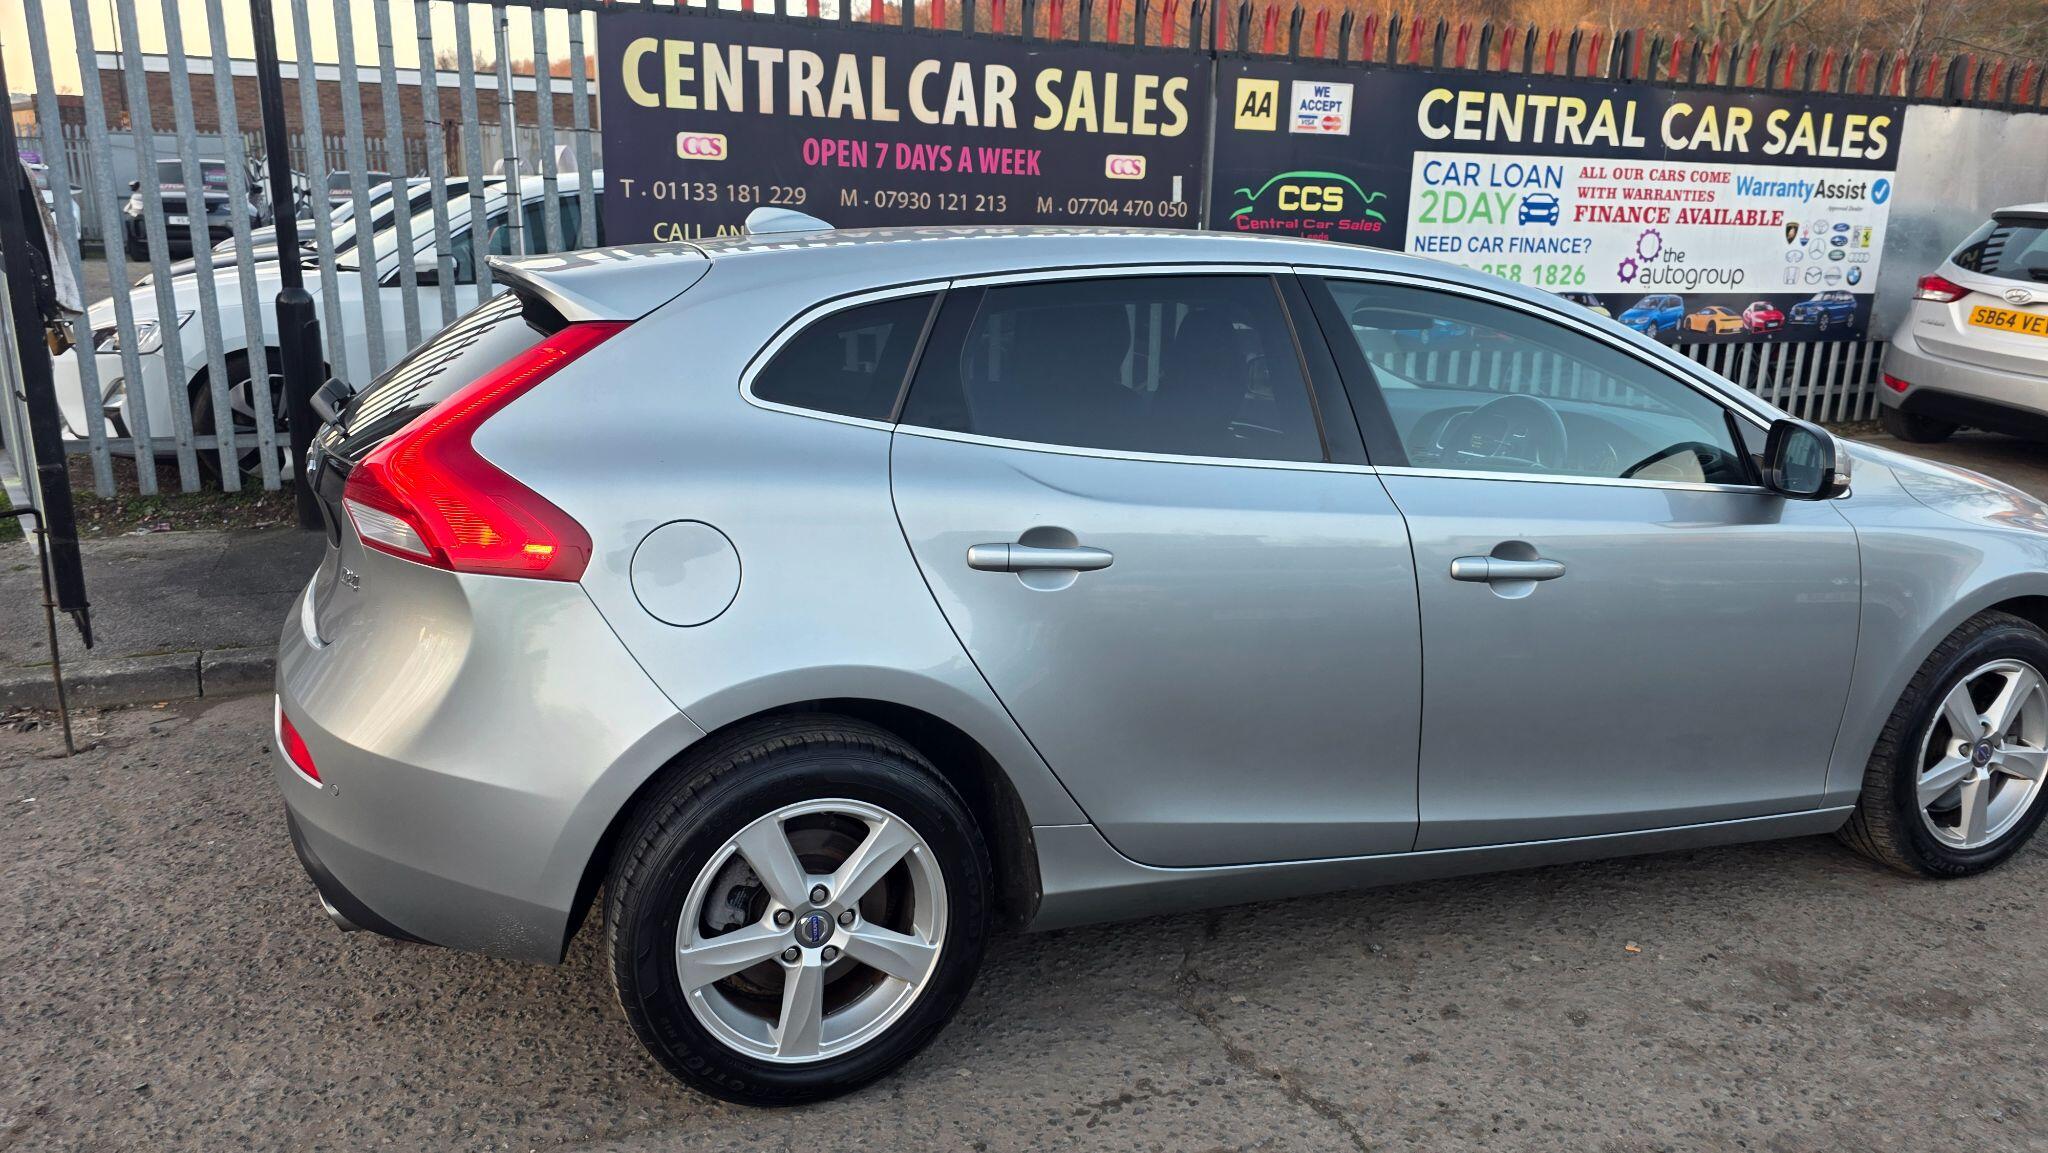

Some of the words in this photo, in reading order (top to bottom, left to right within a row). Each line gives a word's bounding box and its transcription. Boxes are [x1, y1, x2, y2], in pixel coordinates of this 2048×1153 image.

[622, 37, 900, 122] CENTRAL
[908, 59, 1018, 129] CAR
[1033, 67, 1189, 137] SALES
[1314, 86, 1331, 98] WE
[1240, 90, 1272, 118] AA
[1300, 99, 1342, 112] ACCEPT
[1417, 87, 1646, 148] CENTRAL
[1660, 102, 1753, 153] CAR
[1762, 108, 1892, 160] SALES
[802, 137, 868, 169] OPEN
[874, 142, 889, 169] 7
[896, 143, 953, 173] DAYS
[958, 146, 973, 173] A
[978, 147, 1042, 176] WEEK
[1423, 160, 1481, 187] CAR
[1490, 163, 1564, 189] LOAN
[1578, 166, 1607, 180] ALL
[1613, 167, 1644, 181] OUR
[1649, 168, 1686, 182] CARS
[1690, 170, 1731, 184] COME
[652, 180, 718, 202] 01133
[726, 184, 760, 203] 181
[769, 185, 807, 205] 229
[874, 190, 931, 209] 07930
[938, 193, 967, 211] 121
[975, 194, 1007, 213] 213
[1278, 184, 1344, 212] CCS
[1577, 186, 1617, 200] WITH
[1622, 187, 1716, 203] WARRANTIES
[1067, 197, 1119, 216] 07704
[1123, 200, 1154, 217] 470
[1158, 201, 1188, 218] 050
[1418, 189, 1518, 225] 2DAY
[1573, 204, 1671, 225] FINANCE
[1675, 207, 1785, 227] AVAILABLE
[1236, 214, 1298, 230] Central
[1303, 219, 1334, 230] Car
[1338, 218, 1382, 232] Sales
[1414, 235, 1462, 253] NEED
[1467, 236, 1504, 253] CAR
[1508, 237, 1592, 254] FINANCE?
[1663, 247, 1686, 263] the
[1532, 263, 1586, 286] 1826
[1639, 264, 1745, 290] autogroup
[1975, 309, 2017, 328] SB64
[2022, 315, 2048, 335] VE
